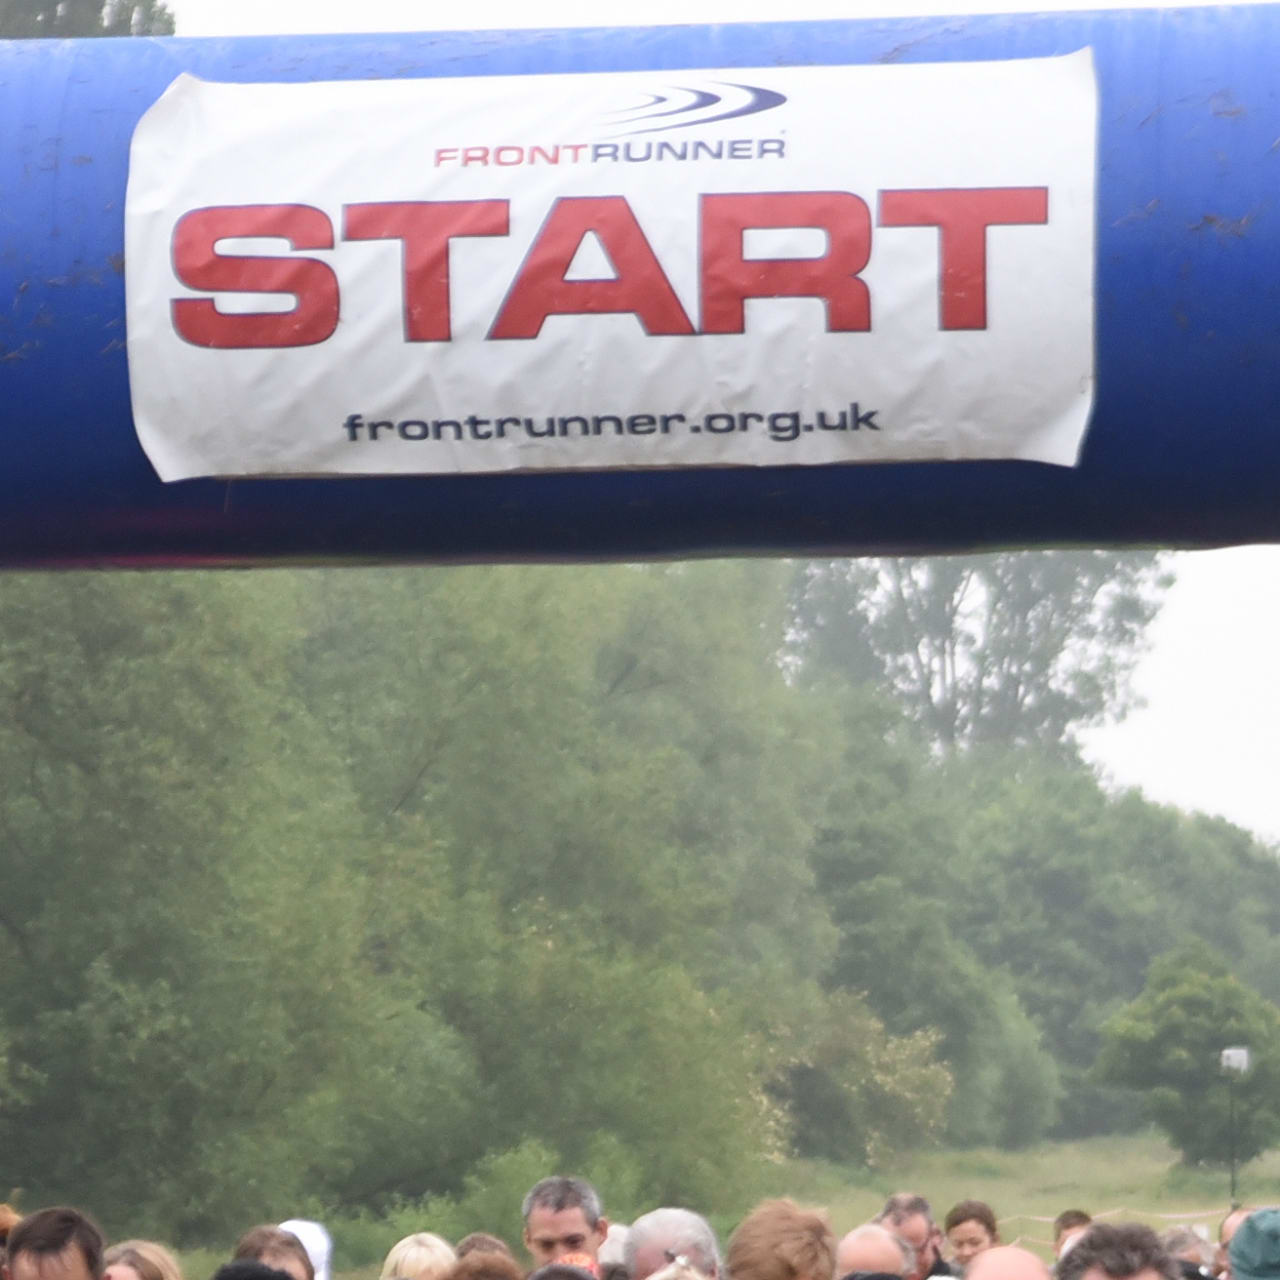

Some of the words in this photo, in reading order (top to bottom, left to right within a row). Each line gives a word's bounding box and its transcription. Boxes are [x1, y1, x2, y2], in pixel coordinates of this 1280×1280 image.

[434, 137, 787, 168] FRONTRUNNER
[169, 186, 1049, 350] START
[342, 402, 881, 443] frontrunner.org.uk
